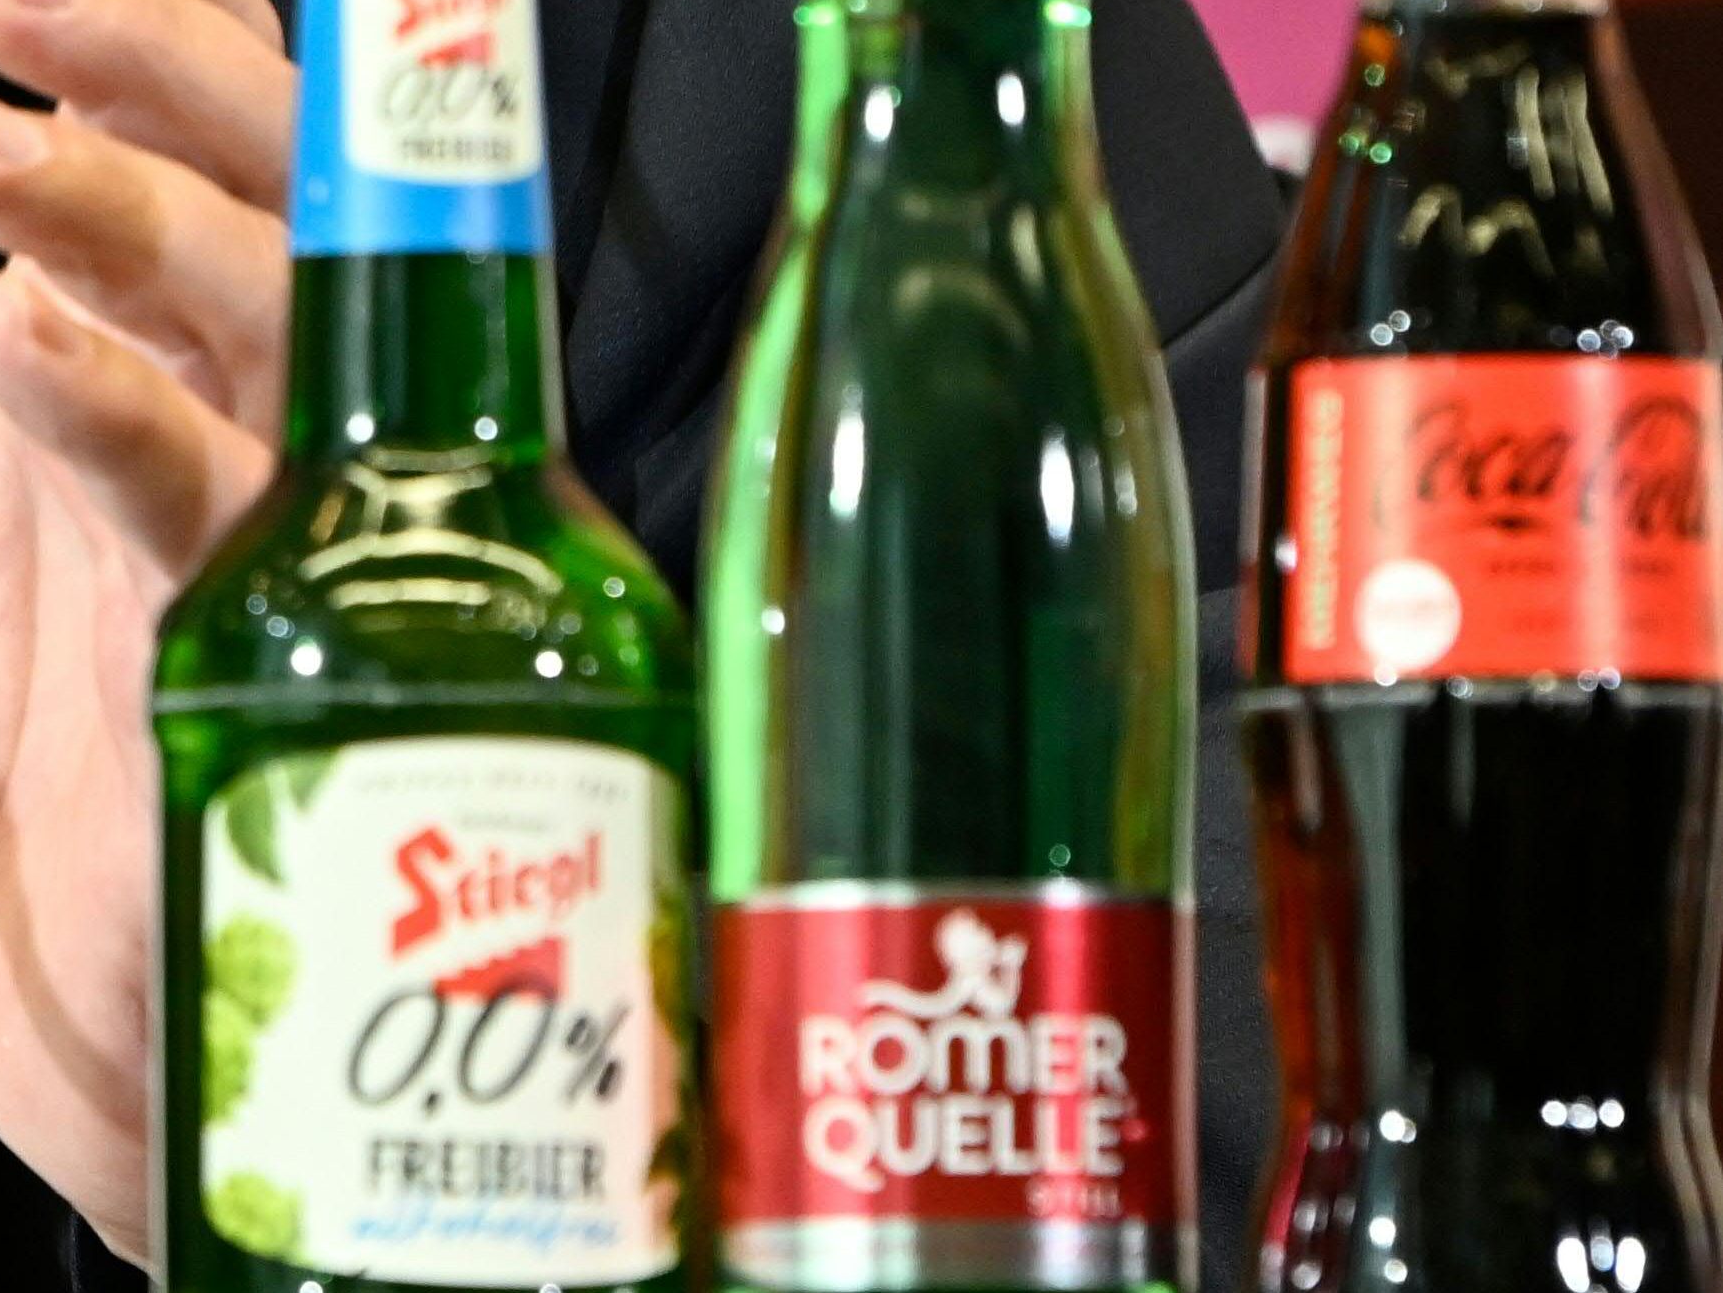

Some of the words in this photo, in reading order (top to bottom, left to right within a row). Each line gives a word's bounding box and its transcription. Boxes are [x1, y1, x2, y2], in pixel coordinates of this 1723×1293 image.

[389, 823, 603, 965] Stiegl
[367, 1135, 605, 1203] FREIBIER
[801, 1093, 1127, 1195] QUELLE
